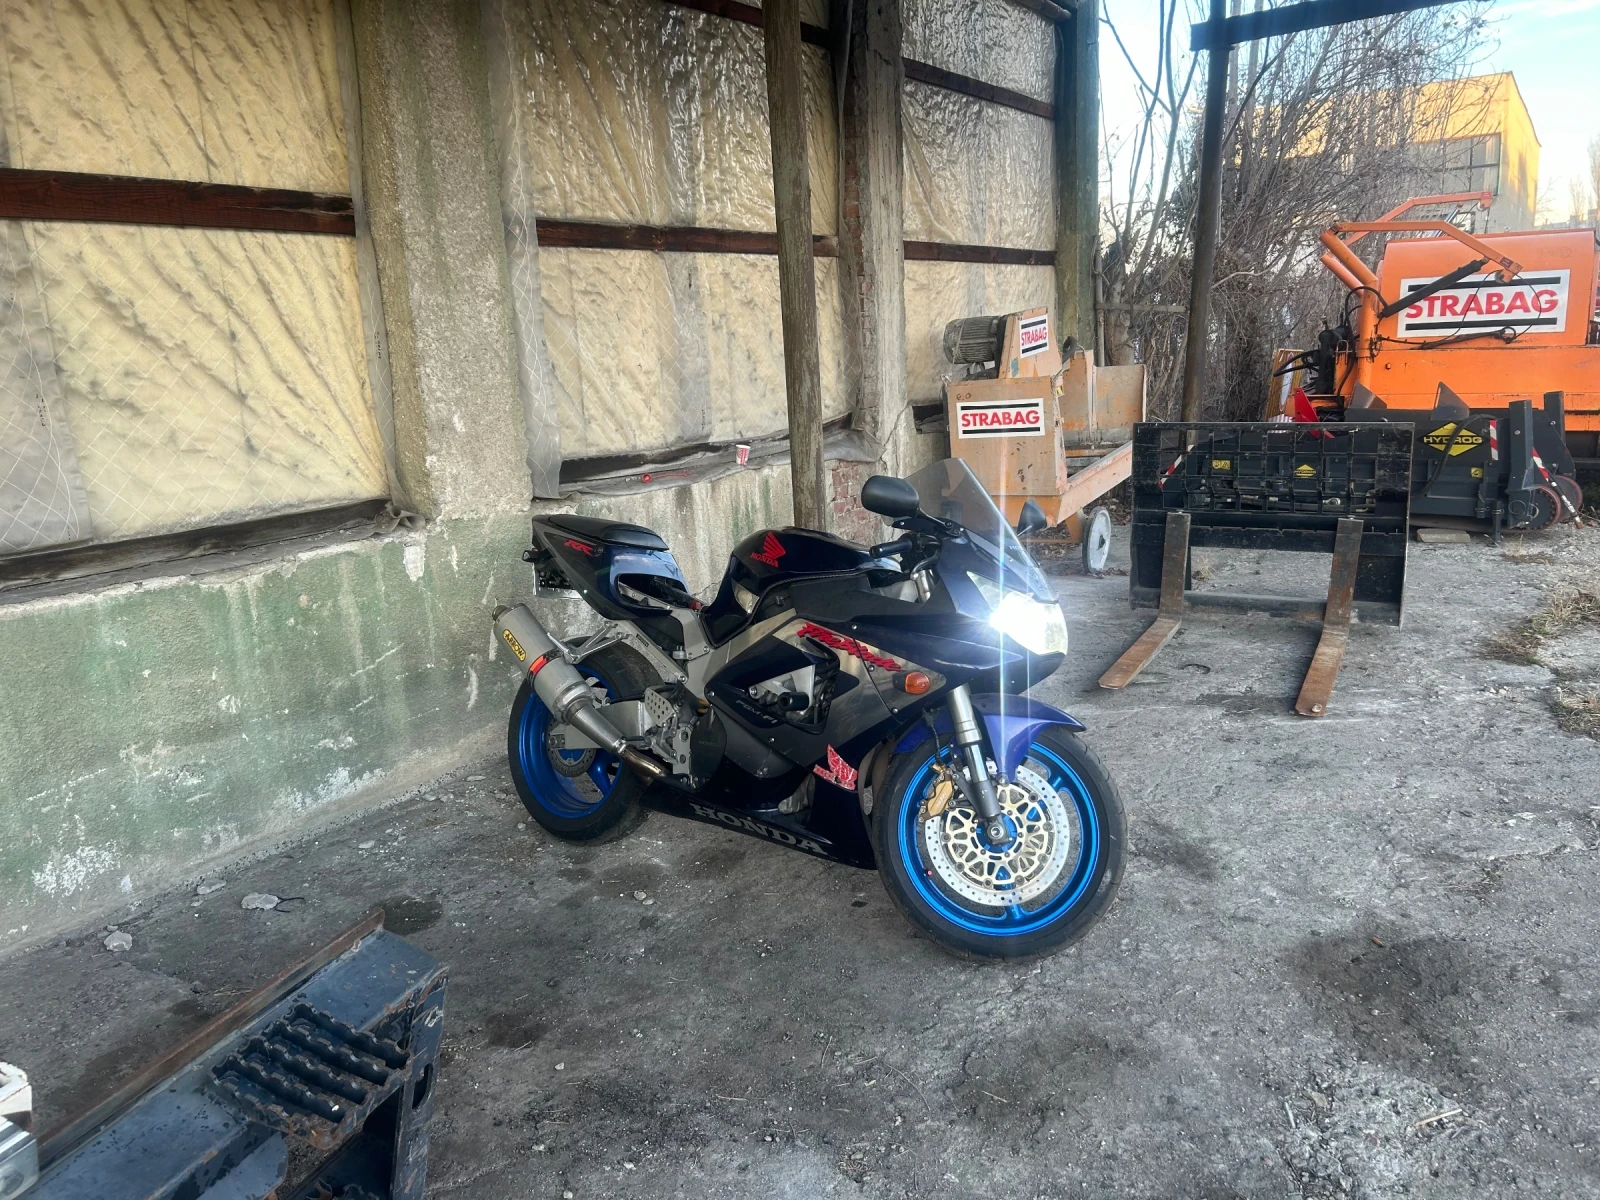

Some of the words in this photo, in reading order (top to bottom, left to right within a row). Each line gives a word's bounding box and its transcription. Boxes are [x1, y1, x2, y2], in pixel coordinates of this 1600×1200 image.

[1405, 289, 1558, 319] STRABAG
[1021, 326, 1048, 346] STRABAG
[961, 410, 1040, 427] STRABAG
[750, 552, 778, 568] HONDA
[504, 632, 524, 656] ARROW
[689, 802, 828, 856] HONDA
